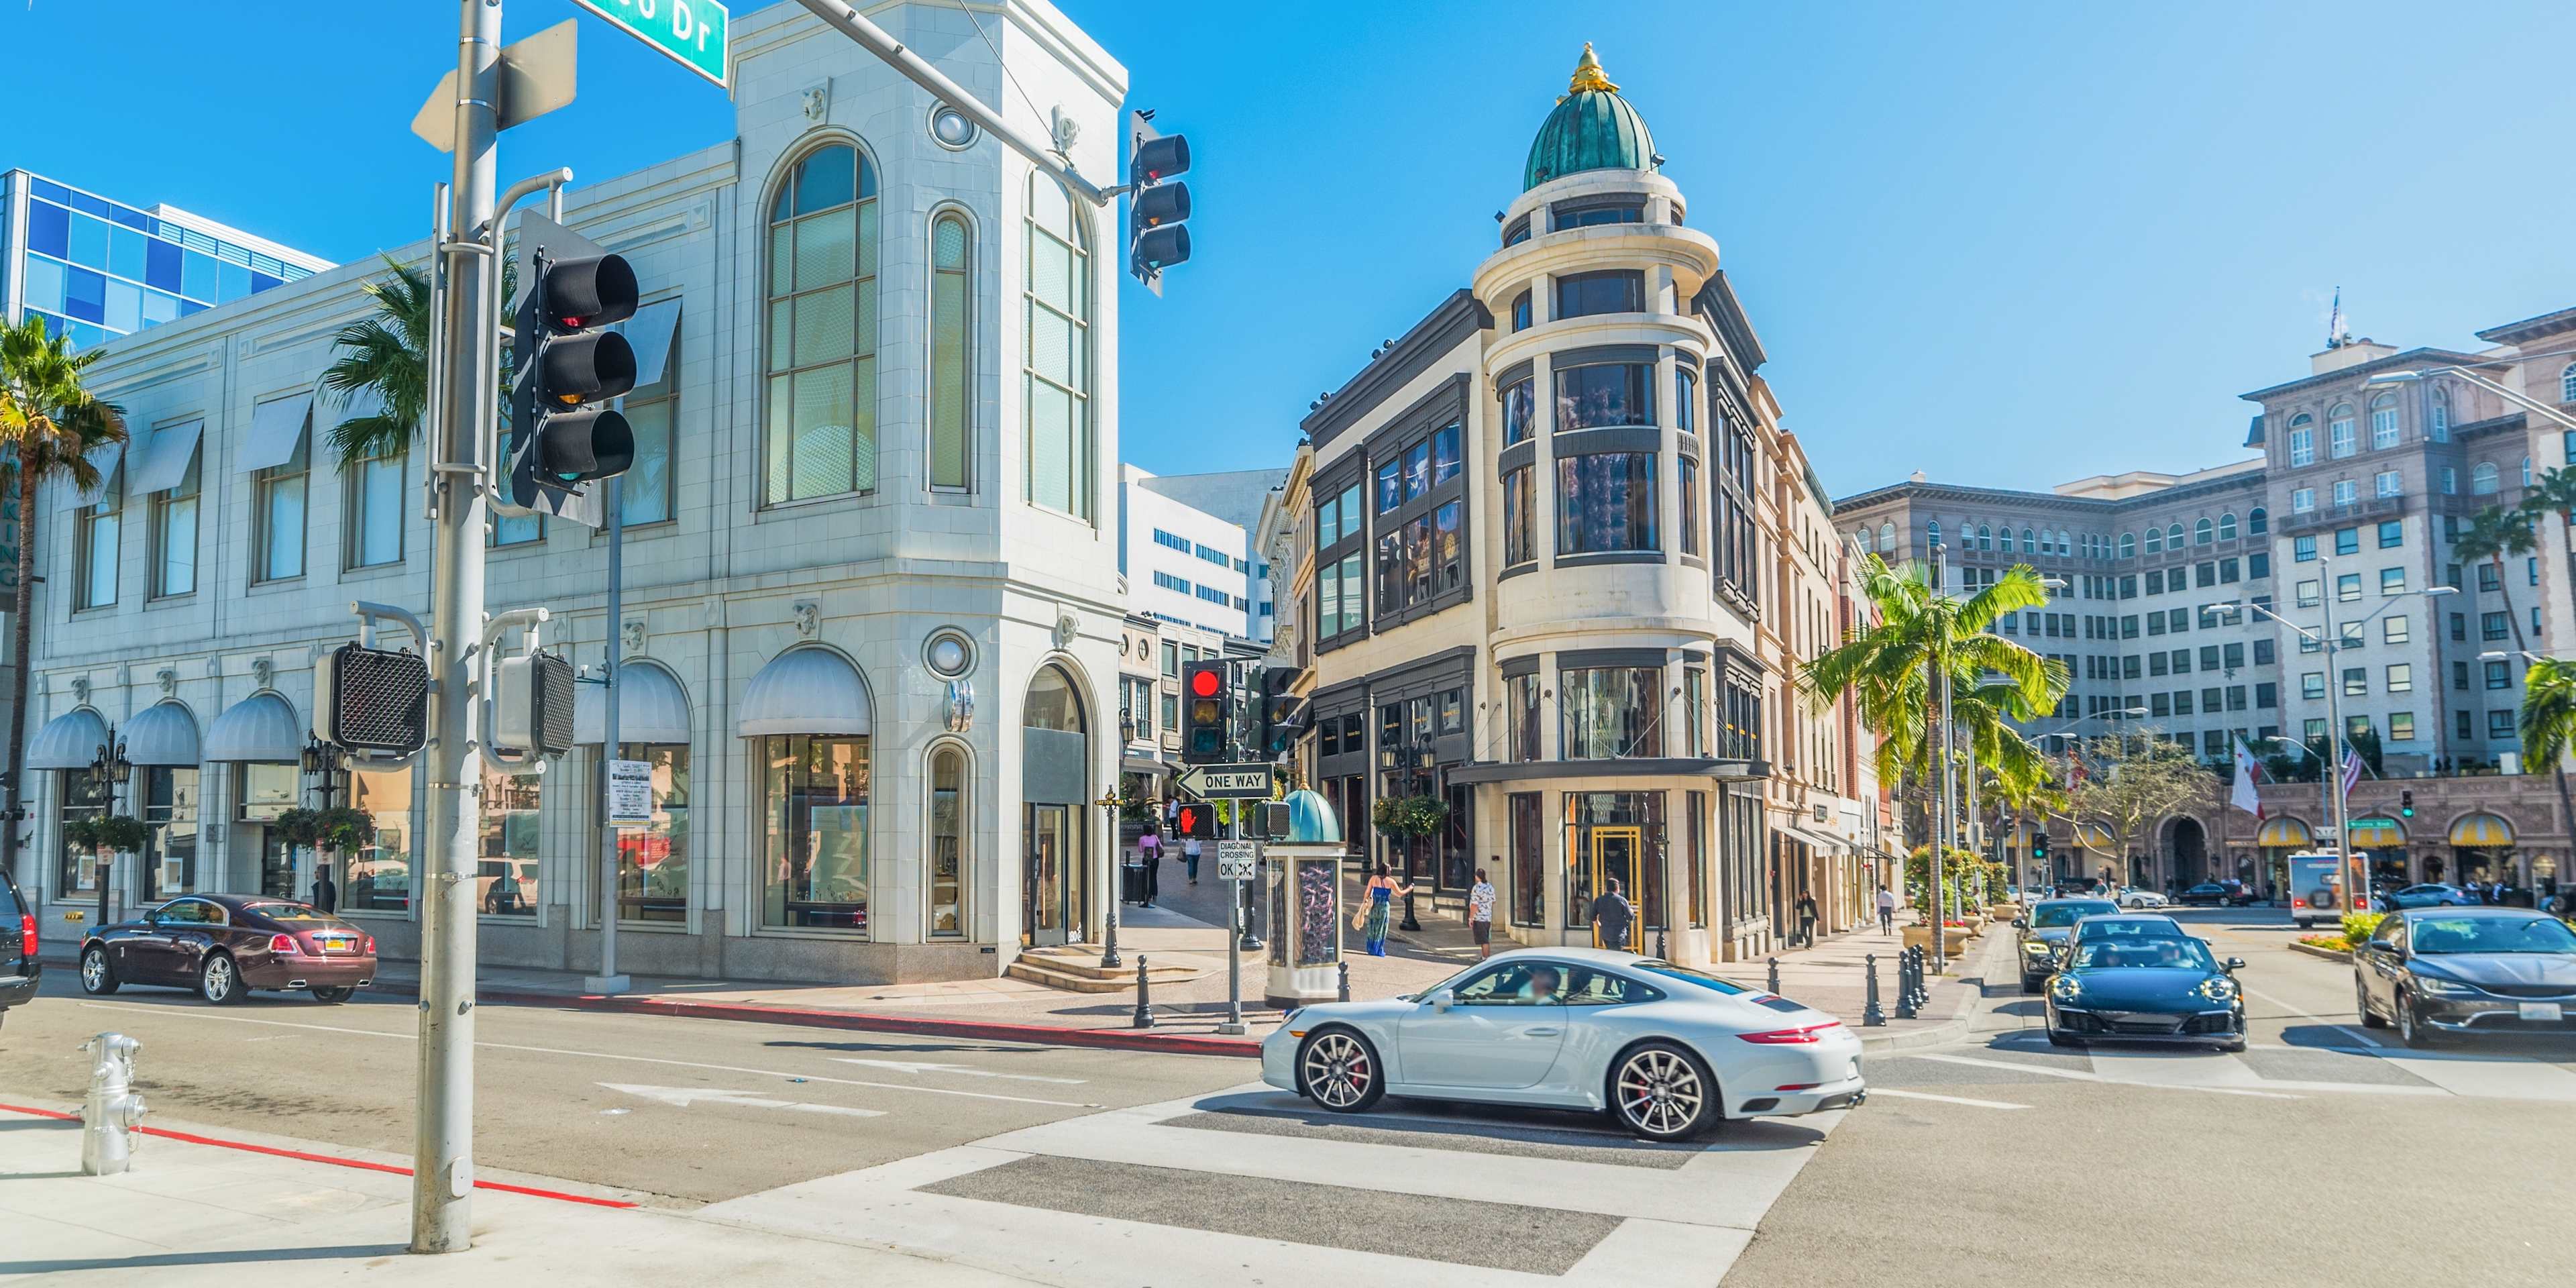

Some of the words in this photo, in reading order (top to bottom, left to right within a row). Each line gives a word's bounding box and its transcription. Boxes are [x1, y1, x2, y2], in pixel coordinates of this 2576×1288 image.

[673, 0, 710, 52] Dr
[1205, 775, 1231, 788] ONE
[1236, 774, 1262, 788] WAY
[1220, 842, 1253, 850] DIAGONAL
[1220, 863, 1234, 875] OK
